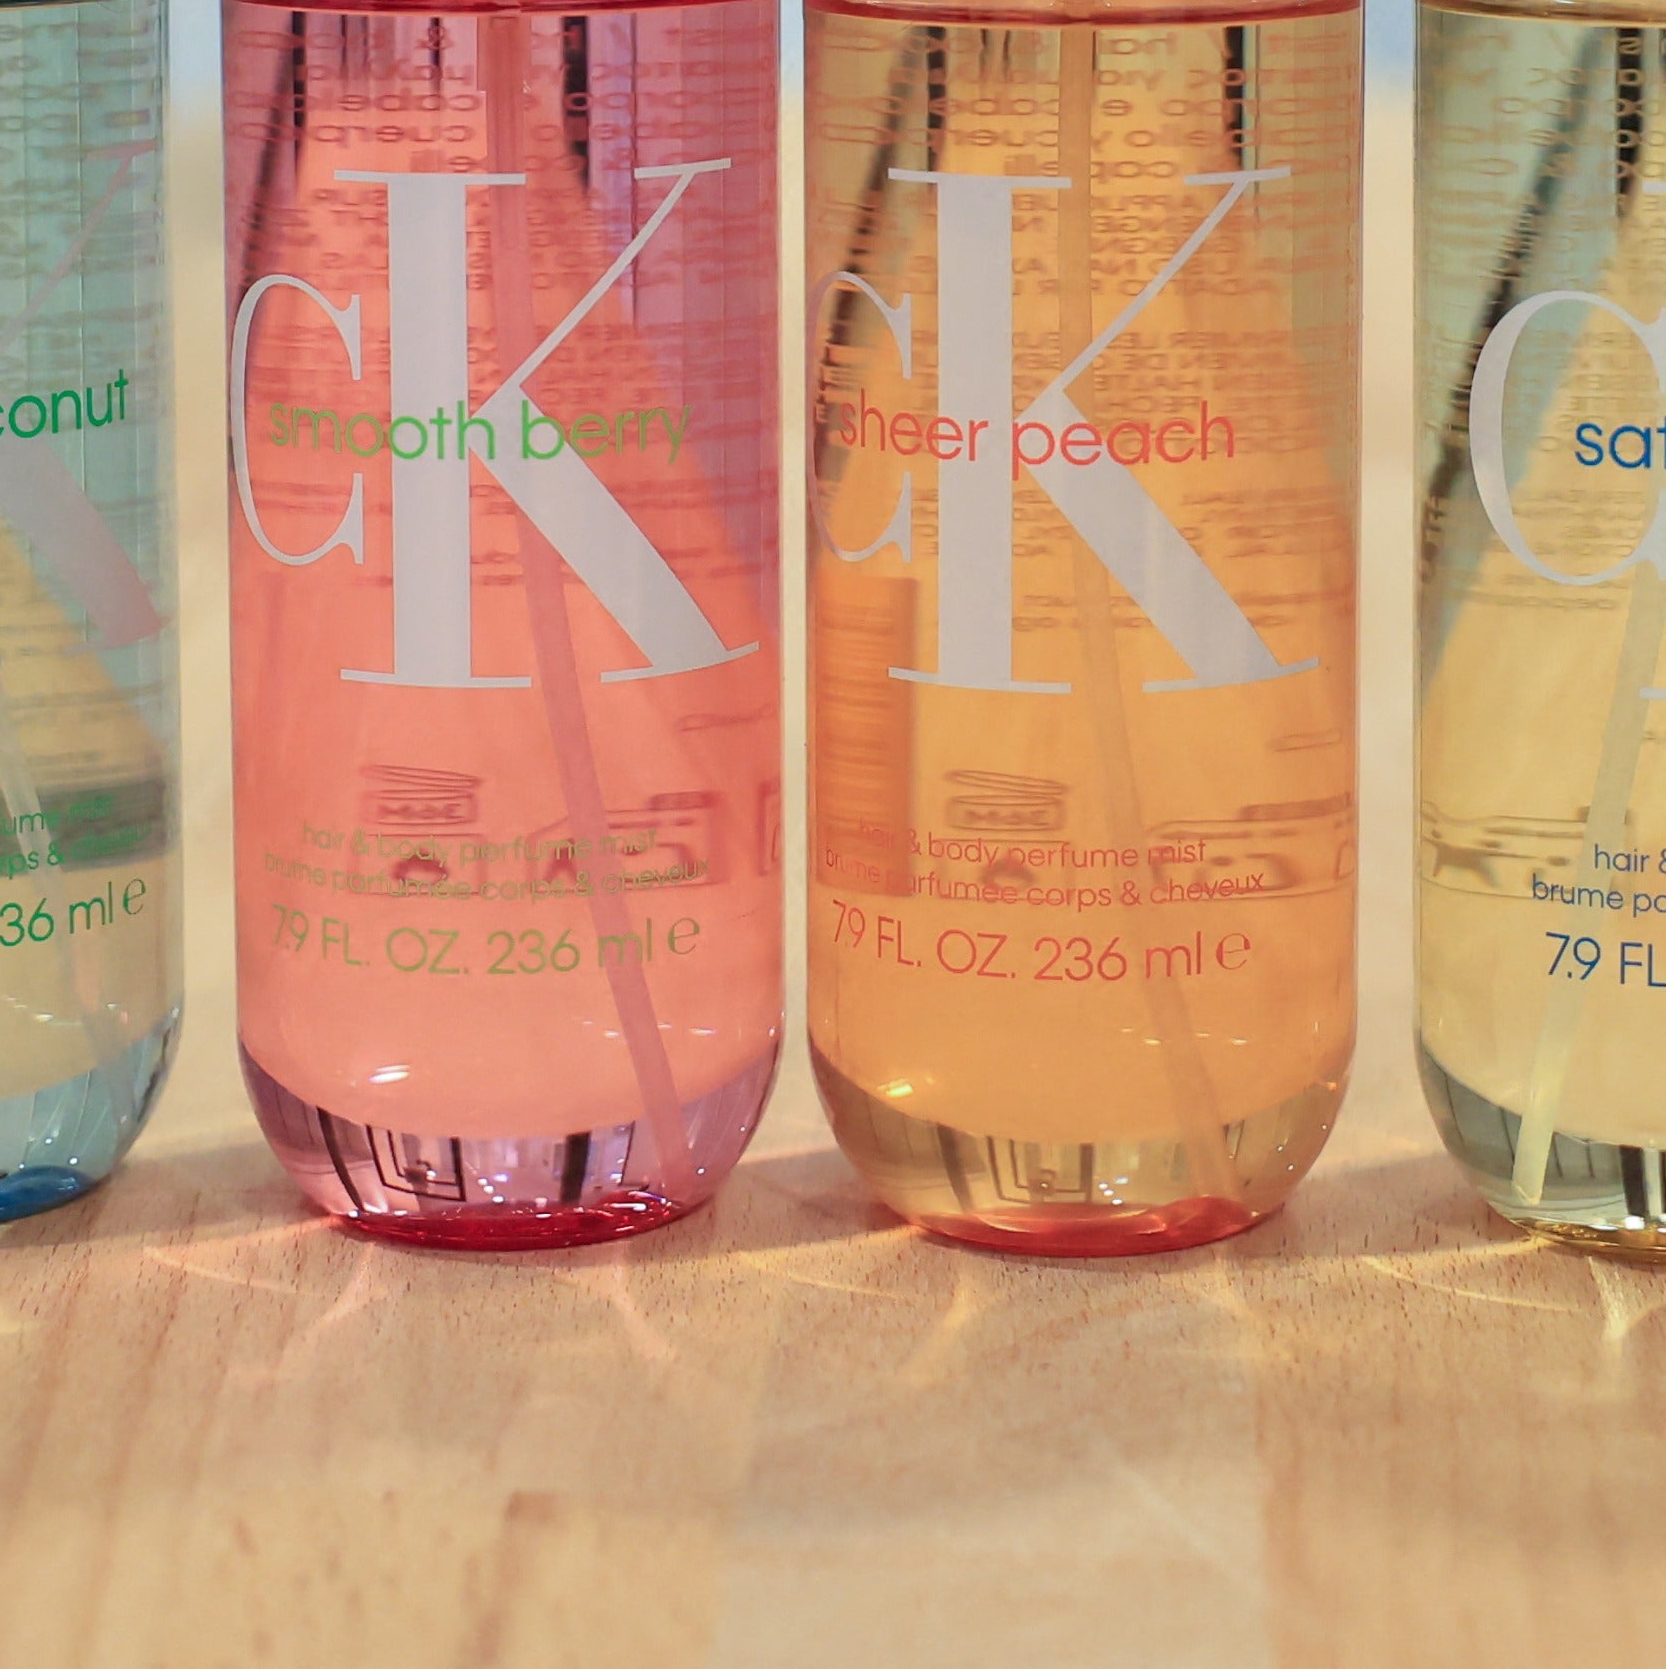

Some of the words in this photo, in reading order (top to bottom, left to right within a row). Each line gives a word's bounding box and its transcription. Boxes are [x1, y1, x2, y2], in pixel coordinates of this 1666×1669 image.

[269, 399, 496, 462] smooth
[521, 399, 693, 464] berry
[839, 388, 989, 463] sheer
[1011, 400, 1235, 481] peach
[46, 841, 66, 868] &
[376, 832, 449, 868] body
[457, 832, 591, 867] perfume
[599, 828, 659, 858] mist
[926, 831, 1000, 868] body
[1006, 842, 1140, 871] perfume
[1146, 838, 1208, 867] mist
[1593, 843, 1651, 875] hair
[478, 875, 567, 903] corps
[572, 870, 596, 898] &
[601, 857, 710, 895] cheveux
[1025, 881, 1113, 914] corps
[1119, 879, 1143, 907] &
[1149, 871, 1266, 906] cheveux
[1531, 873, 1625, 911] brume
[68, 879, 114, 936] ml
[271, 903, 311, 954] 7.9
[320, 916, 371, 968] FL.
[385, 927, 470, 975] OZ.
[486, 928, 582, 975] 236
[597, 916, 653, 969] ml
[876, 915, 923, 969] FL.
[936, 929, 1018, 980] OZ.
[1033, 936, 1128, 982] 236
[1144, 930, 1203, 980] ml
[1544, 930, 1602, 982] 7.9
